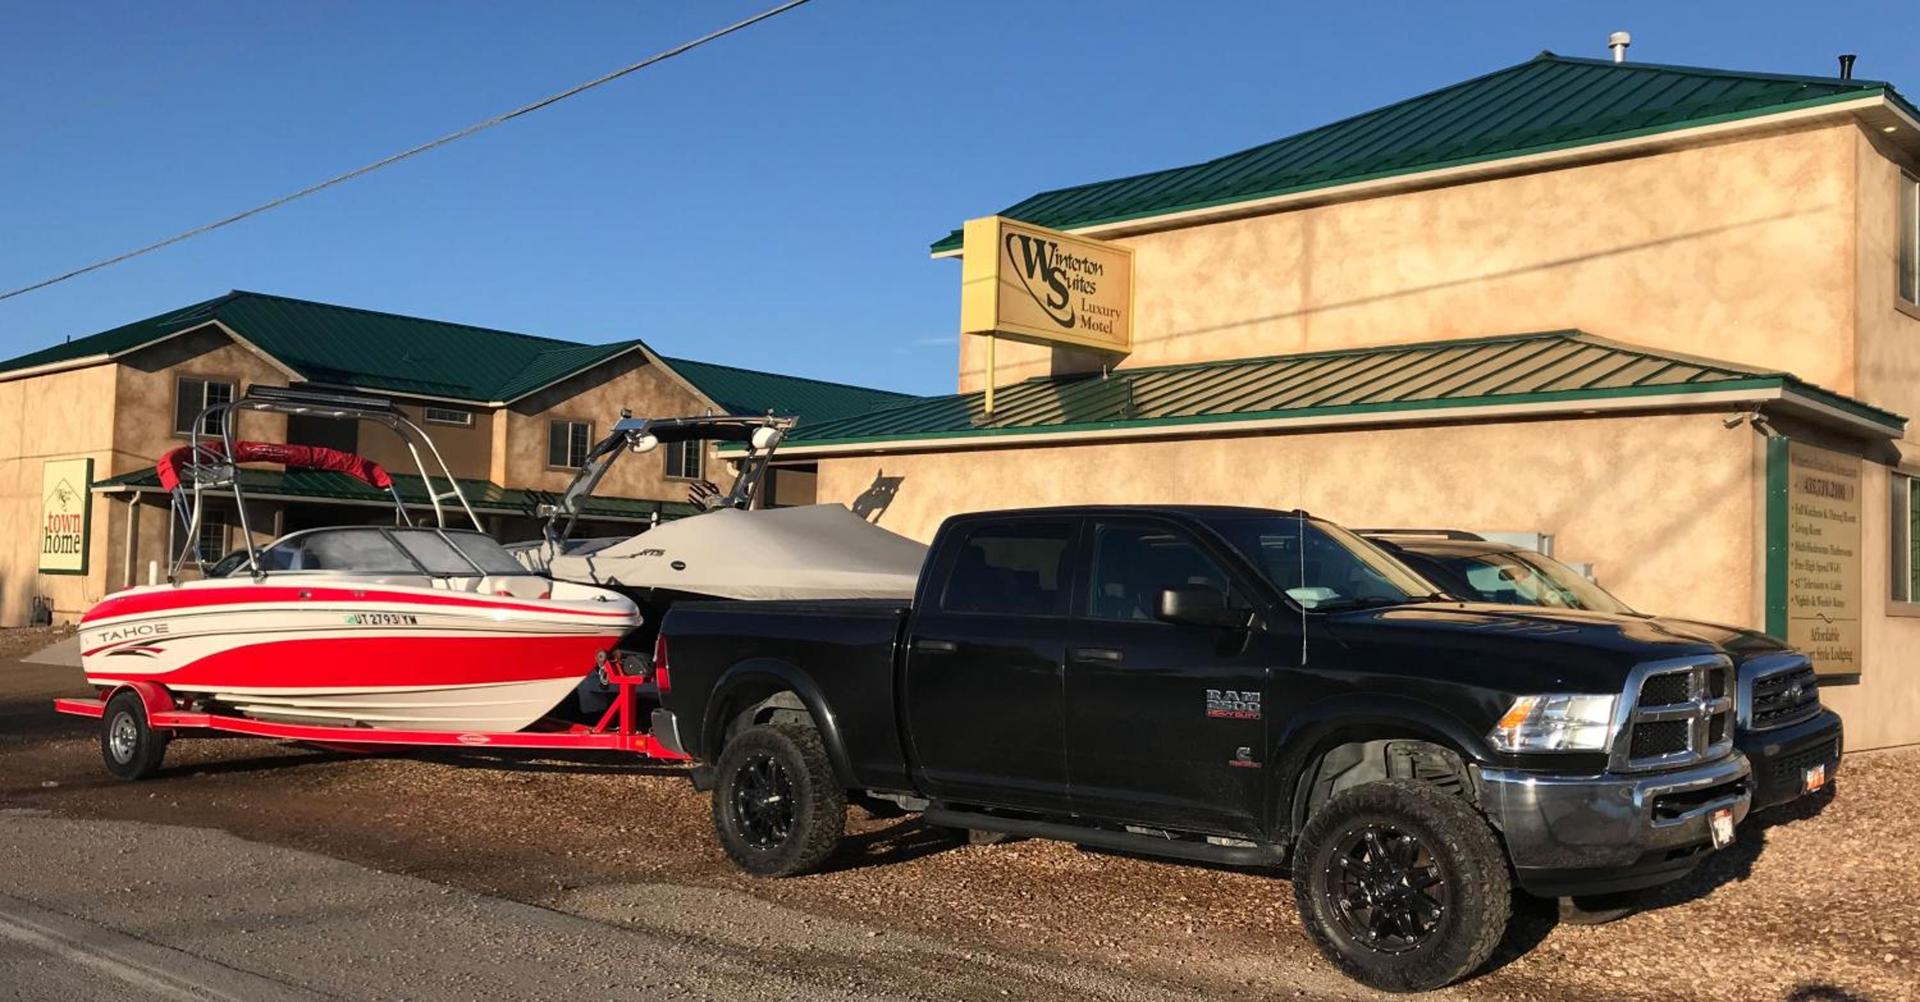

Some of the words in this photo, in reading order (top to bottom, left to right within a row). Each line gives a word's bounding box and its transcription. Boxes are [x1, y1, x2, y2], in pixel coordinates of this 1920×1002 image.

[1017, 234, 1104, 282] Winterton
[1046, 266, 1097, 310] Suites
[1080, 298, 1122, 320] Luxury
[1080, 314, 1114, 335] Motel
[48, 512, 81, 534] town
[43, 526, 81, 554] home
[98, 623, 170, 642] TAHOE
[1206, 689, 1261, 702] RAM
